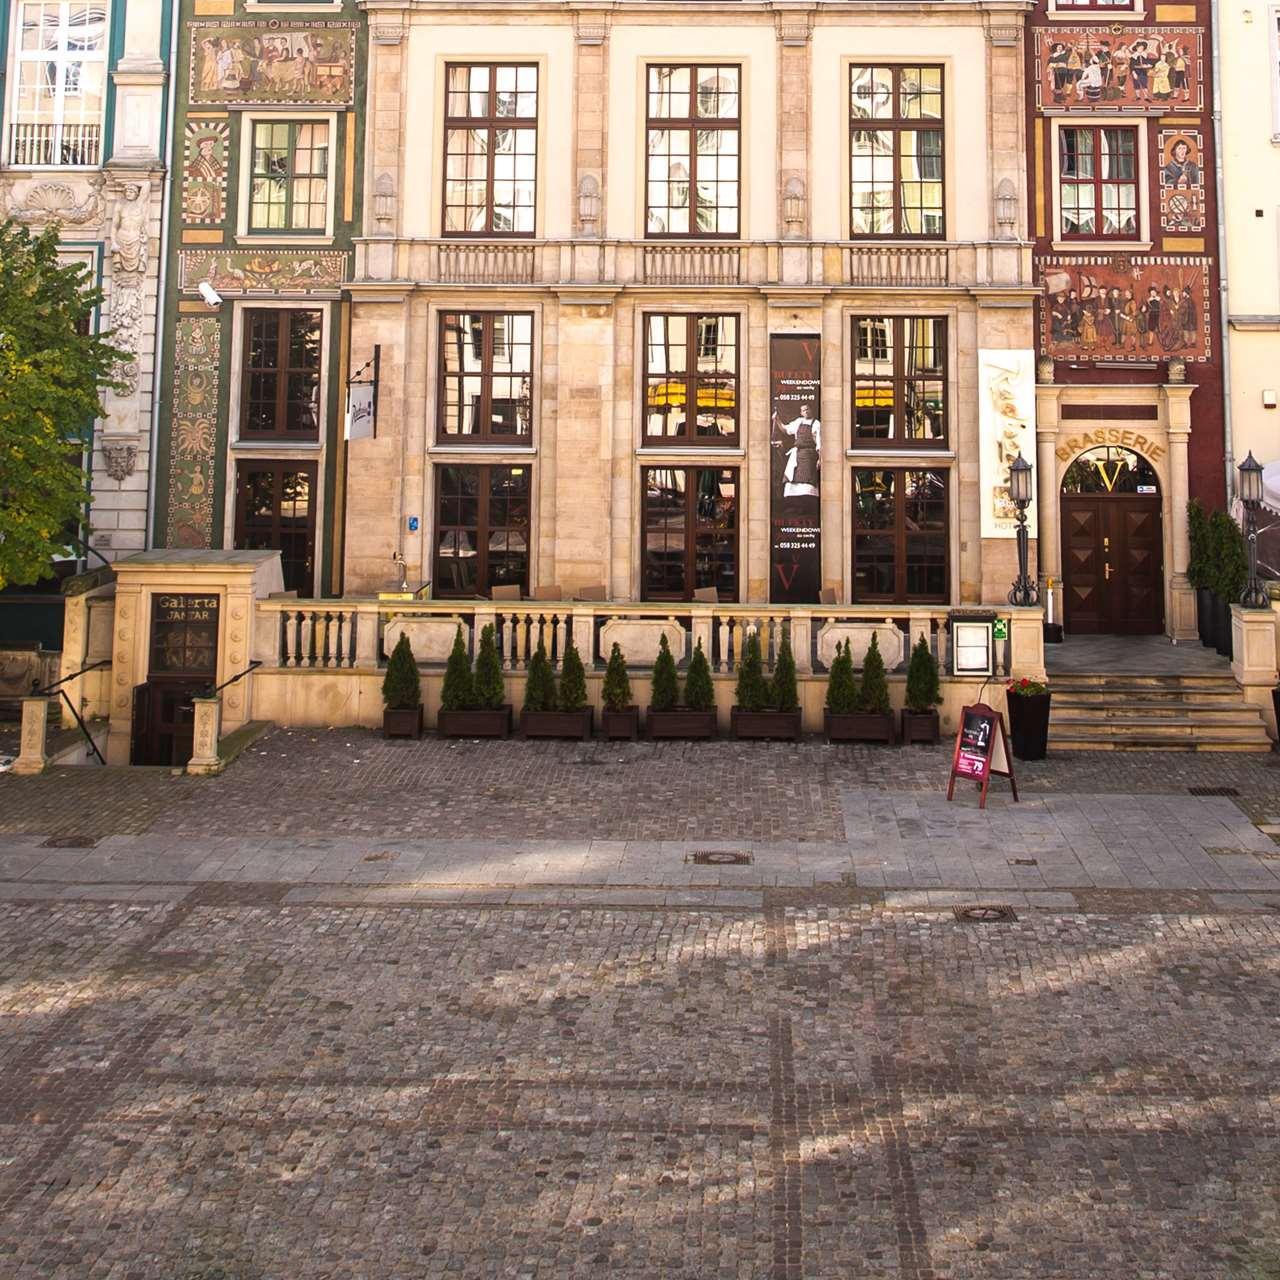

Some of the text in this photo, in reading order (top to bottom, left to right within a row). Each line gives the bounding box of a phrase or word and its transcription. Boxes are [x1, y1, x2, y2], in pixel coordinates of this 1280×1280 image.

[1055, 428, 1166, 462] BRASSERIE
[1093, 460, 1126, 492] V
[167, 611, 209, 620] JANTAR
